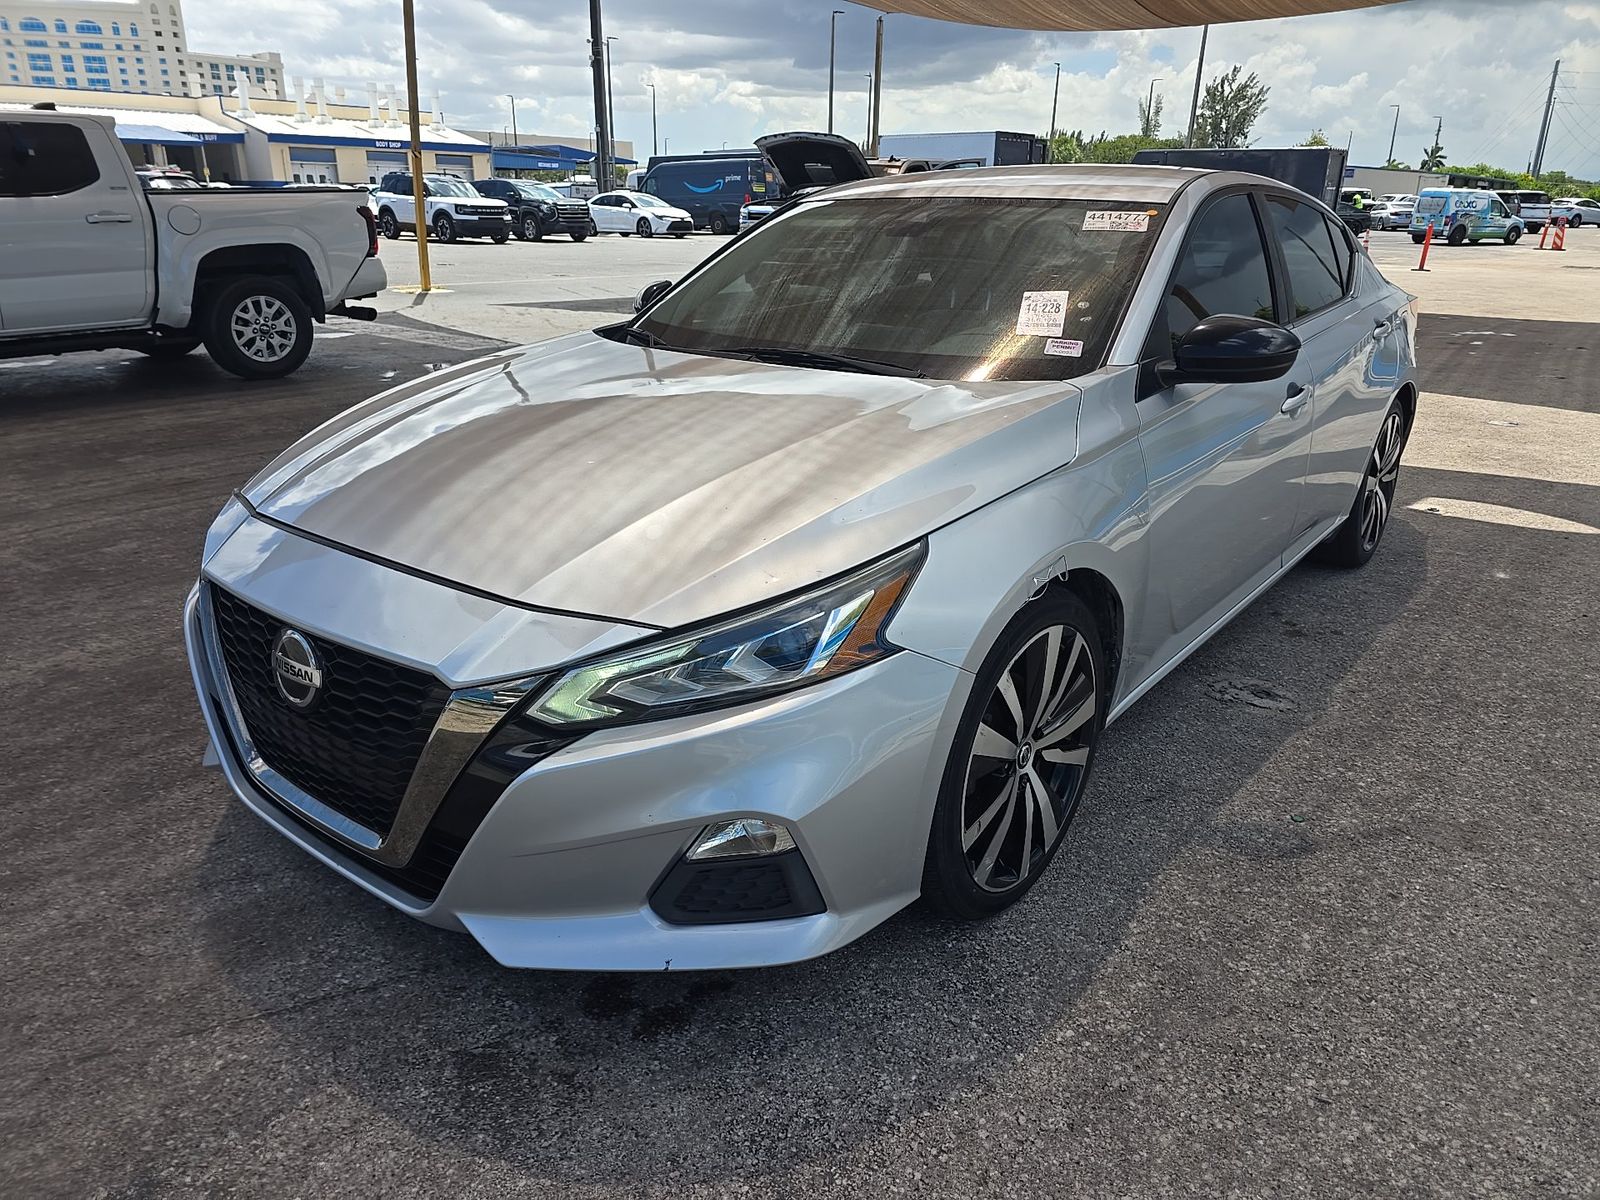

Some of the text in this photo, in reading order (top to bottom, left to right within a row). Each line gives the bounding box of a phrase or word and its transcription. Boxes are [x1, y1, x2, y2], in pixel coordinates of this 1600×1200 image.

[375, 140, 402, 149] BODY SHOP
[725, 174, 741, 183] prime
[275, 656, 314, 683] NISSAN
